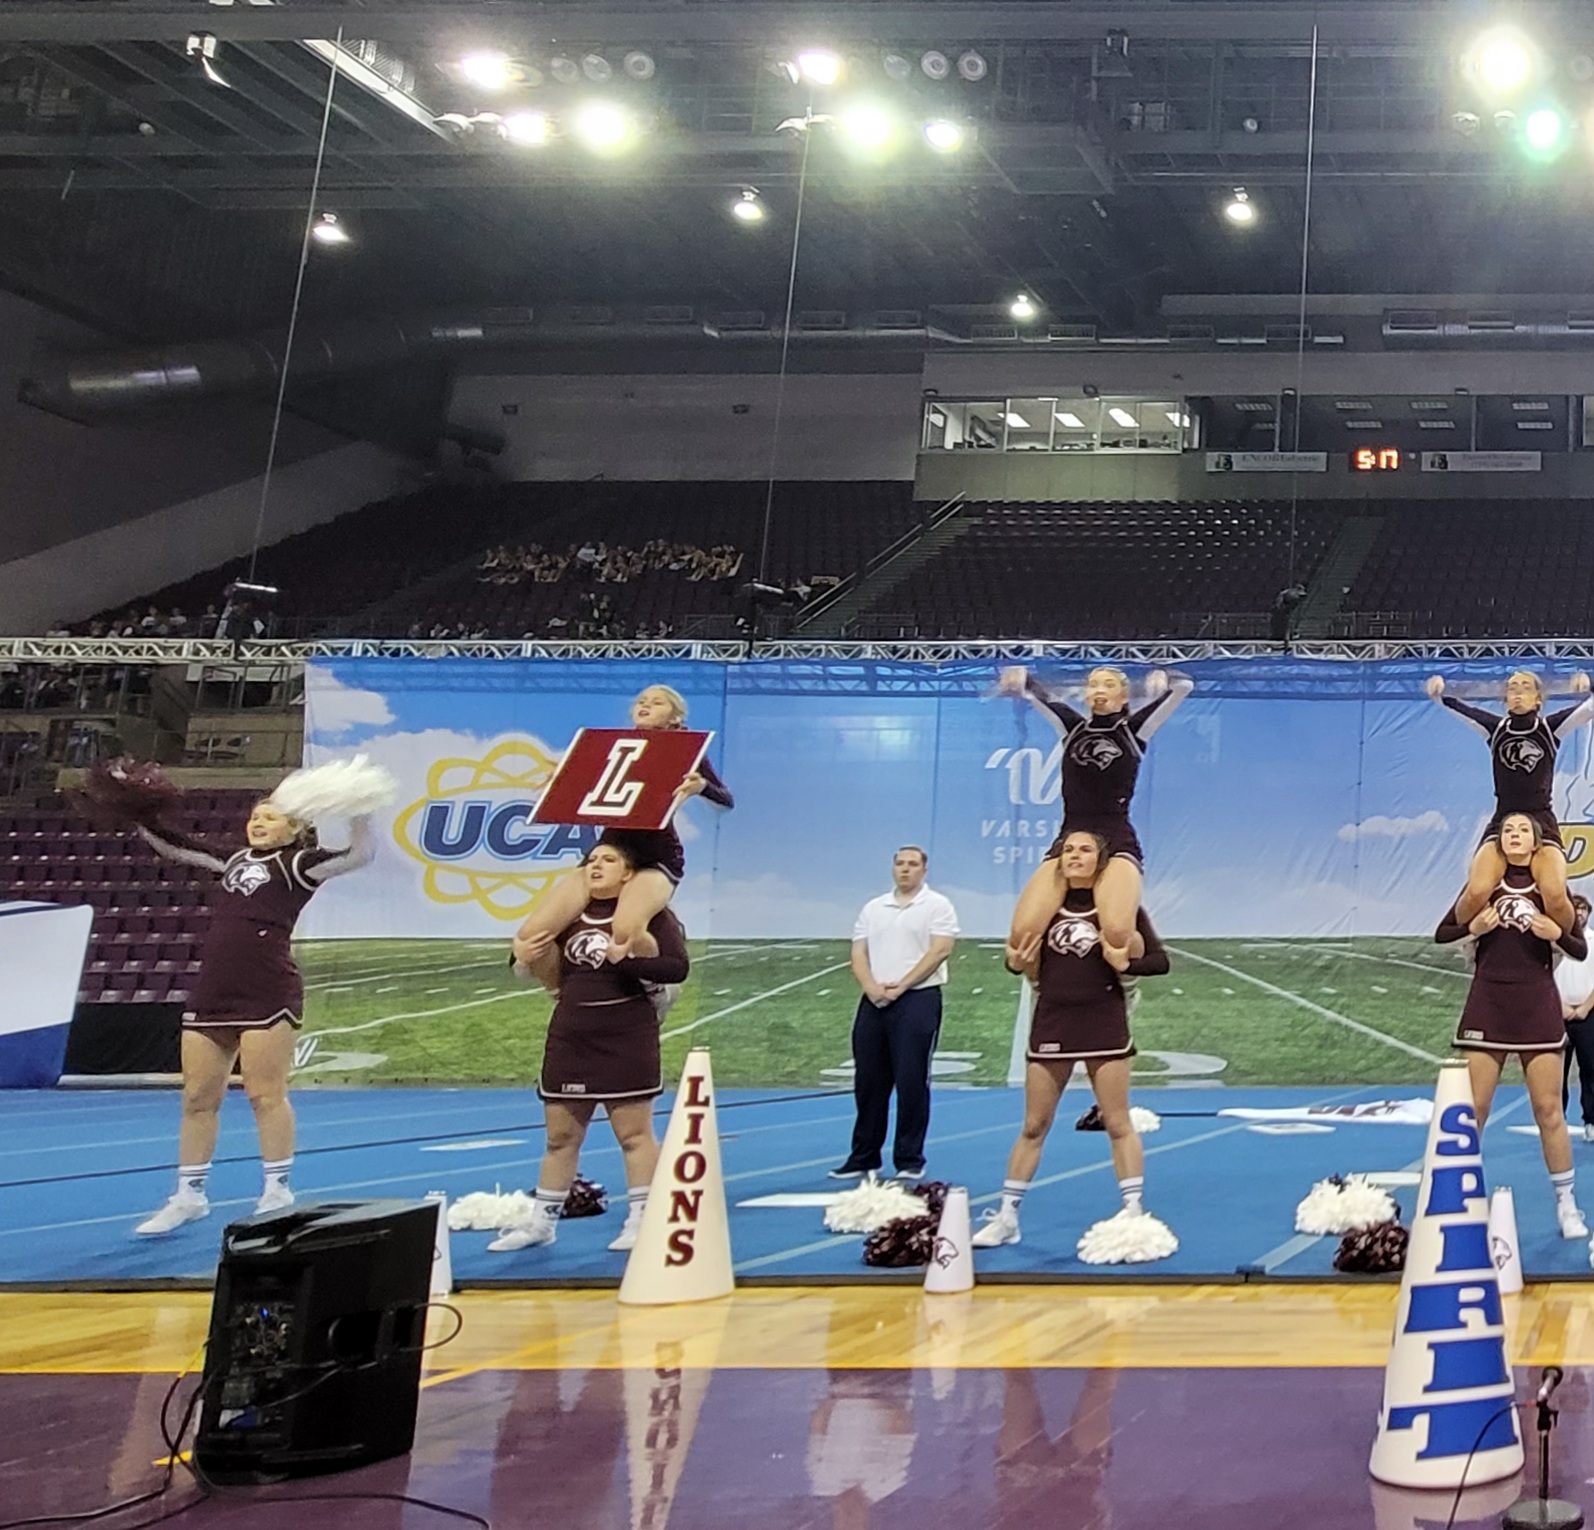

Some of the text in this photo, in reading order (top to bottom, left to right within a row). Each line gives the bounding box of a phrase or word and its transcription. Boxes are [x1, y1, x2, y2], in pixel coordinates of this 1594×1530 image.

[420, 801, 597, 861] UCA
[577, 738, 649, 816] L
[664, 1076, 711, 1268] LIONS
[1386, 1104, 1520, 1462] SPIRIT
